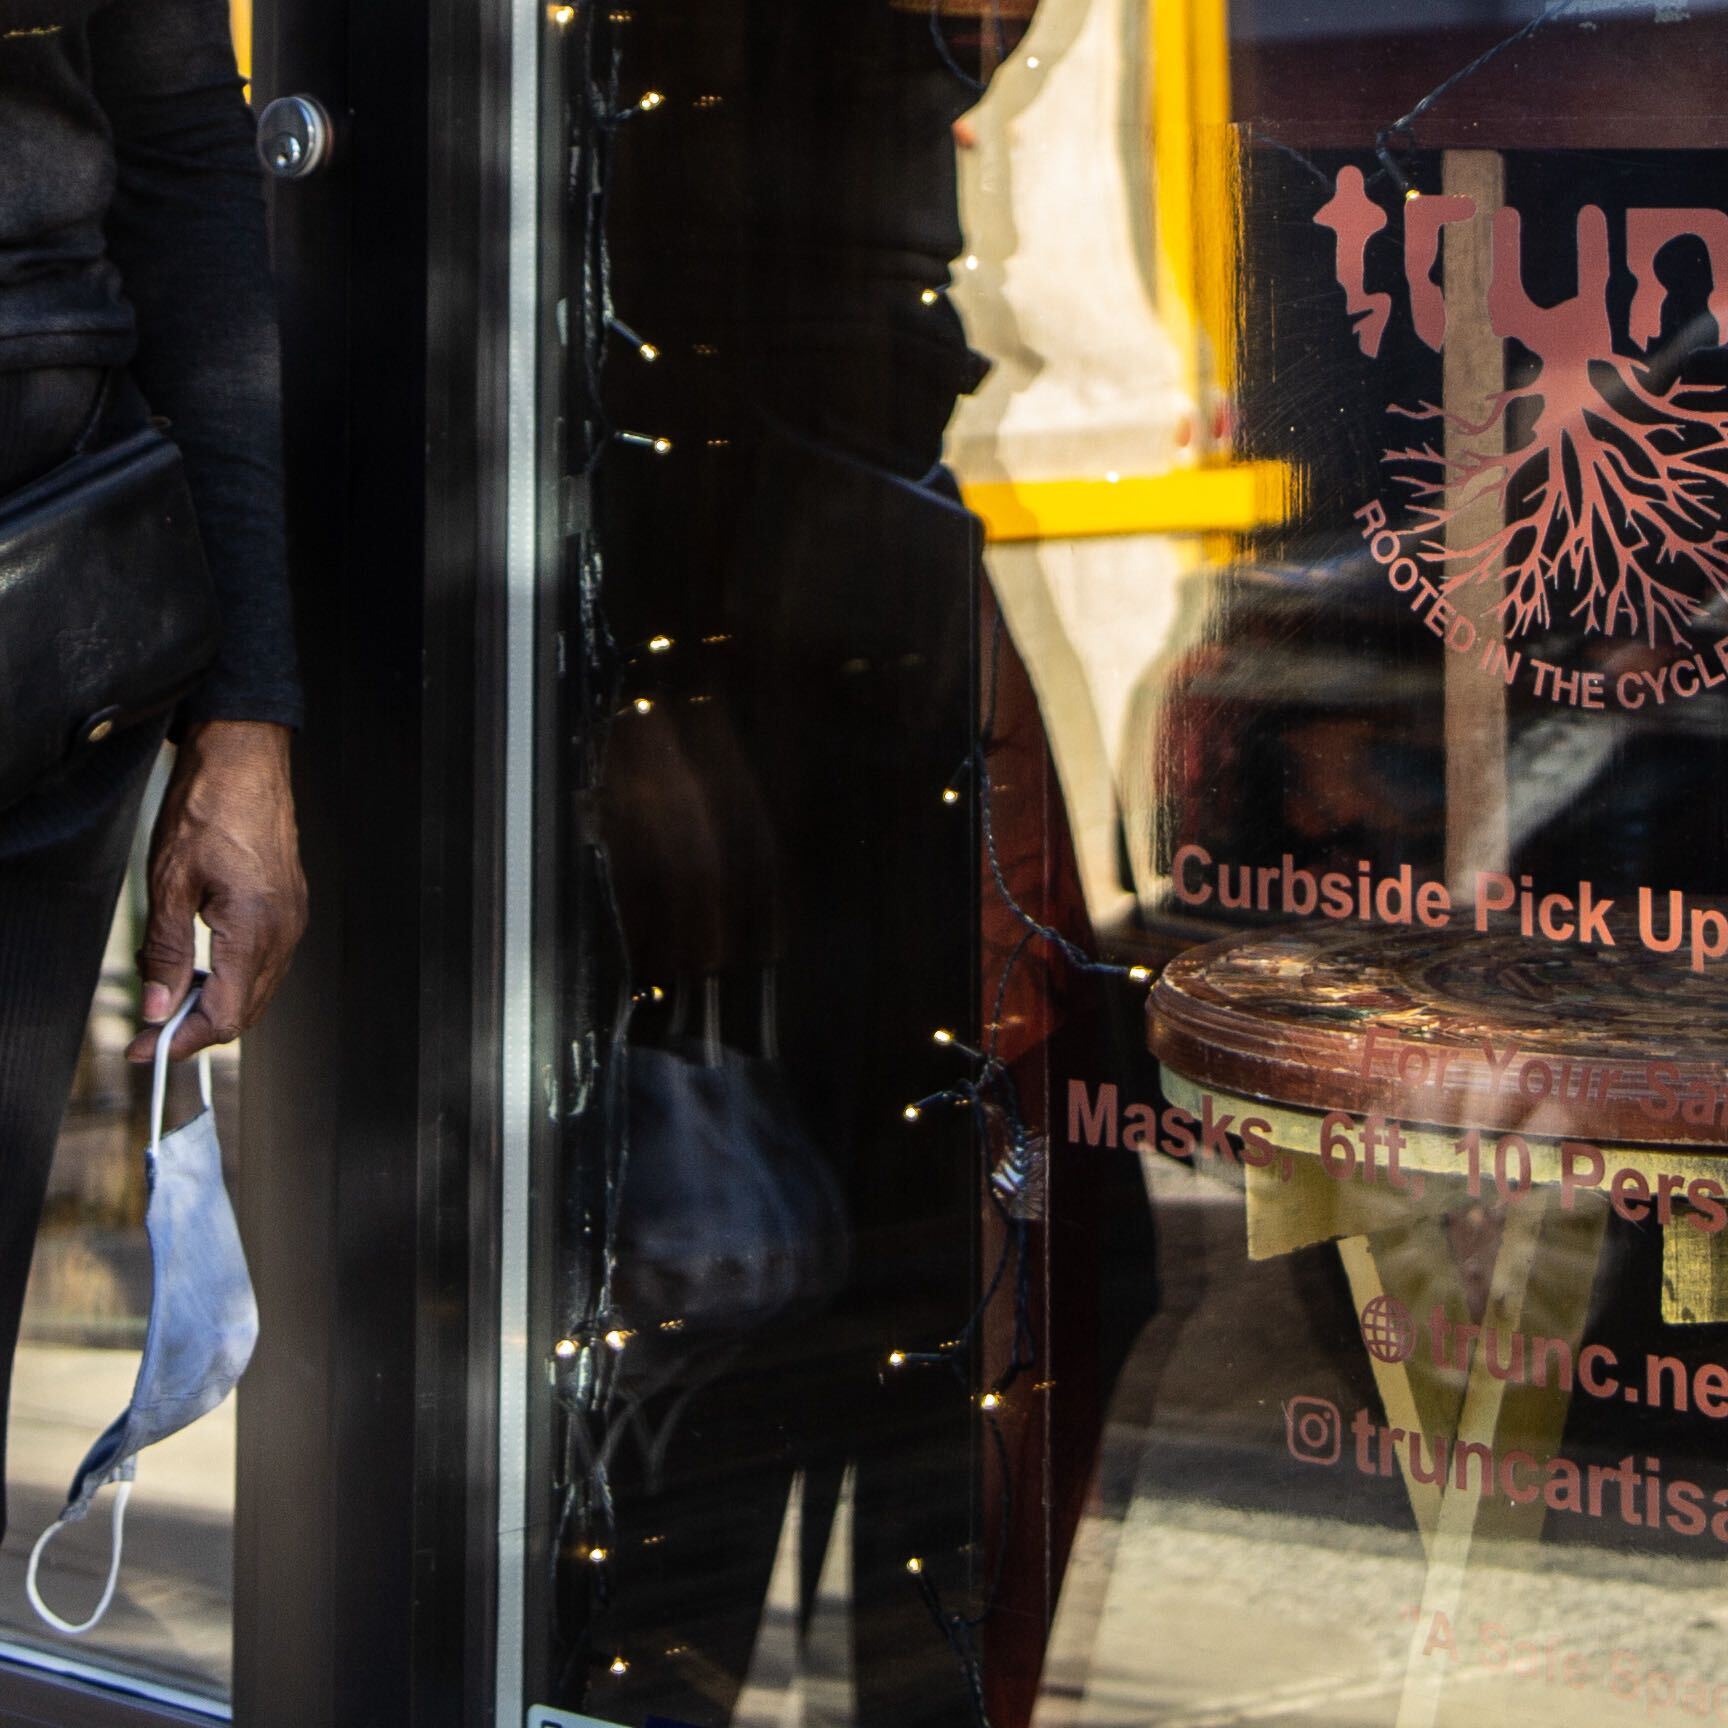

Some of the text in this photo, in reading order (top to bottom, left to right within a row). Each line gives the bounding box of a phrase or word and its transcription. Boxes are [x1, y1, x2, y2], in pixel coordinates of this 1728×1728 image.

[1353, 498, 1477, 652] ROOTED
[1480, 638, 1522, 686] IN
[1529, 658, 1605, 709] THE
[1169, 842, 1452, 930] Curbside
[1474, 870, 1618, 948] Pick
[1362, 1025, 1461, 1088] For
[1474, 1045, 1619, 1113] Your
[1065, 1078, 1297, 1183] Masks,
[1318, 1110, 1428, 1199] 6ft,
[1450, 1131, 1535, 1200] 10
